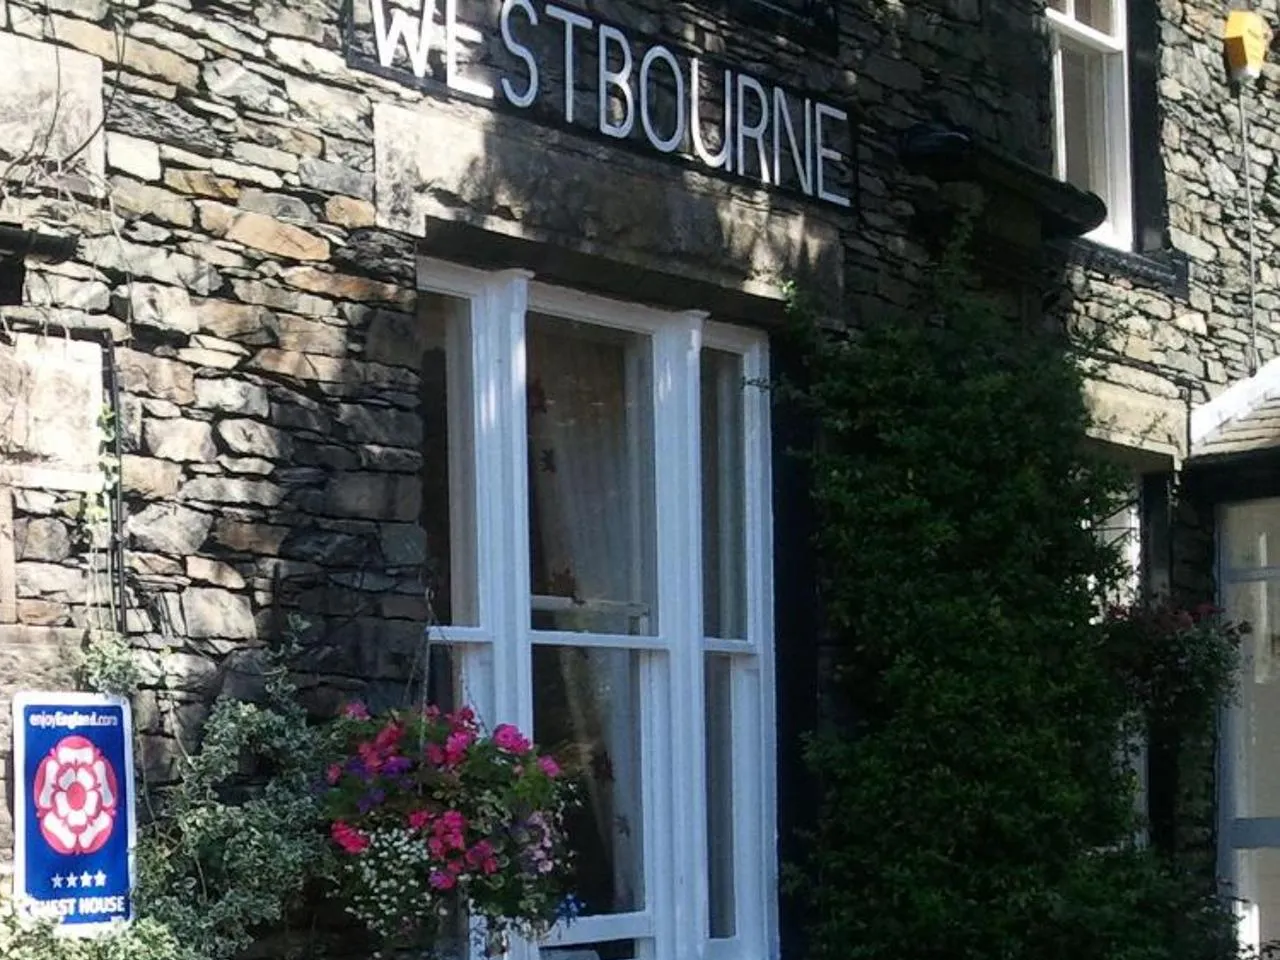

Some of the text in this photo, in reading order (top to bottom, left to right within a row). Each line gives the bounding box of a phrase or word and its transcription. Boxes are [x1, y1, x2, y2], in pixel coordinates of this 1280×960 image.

[371, 0, 851, 207] WESTBOURNE
[33, 896, 125, 915] UEST HOUSE
